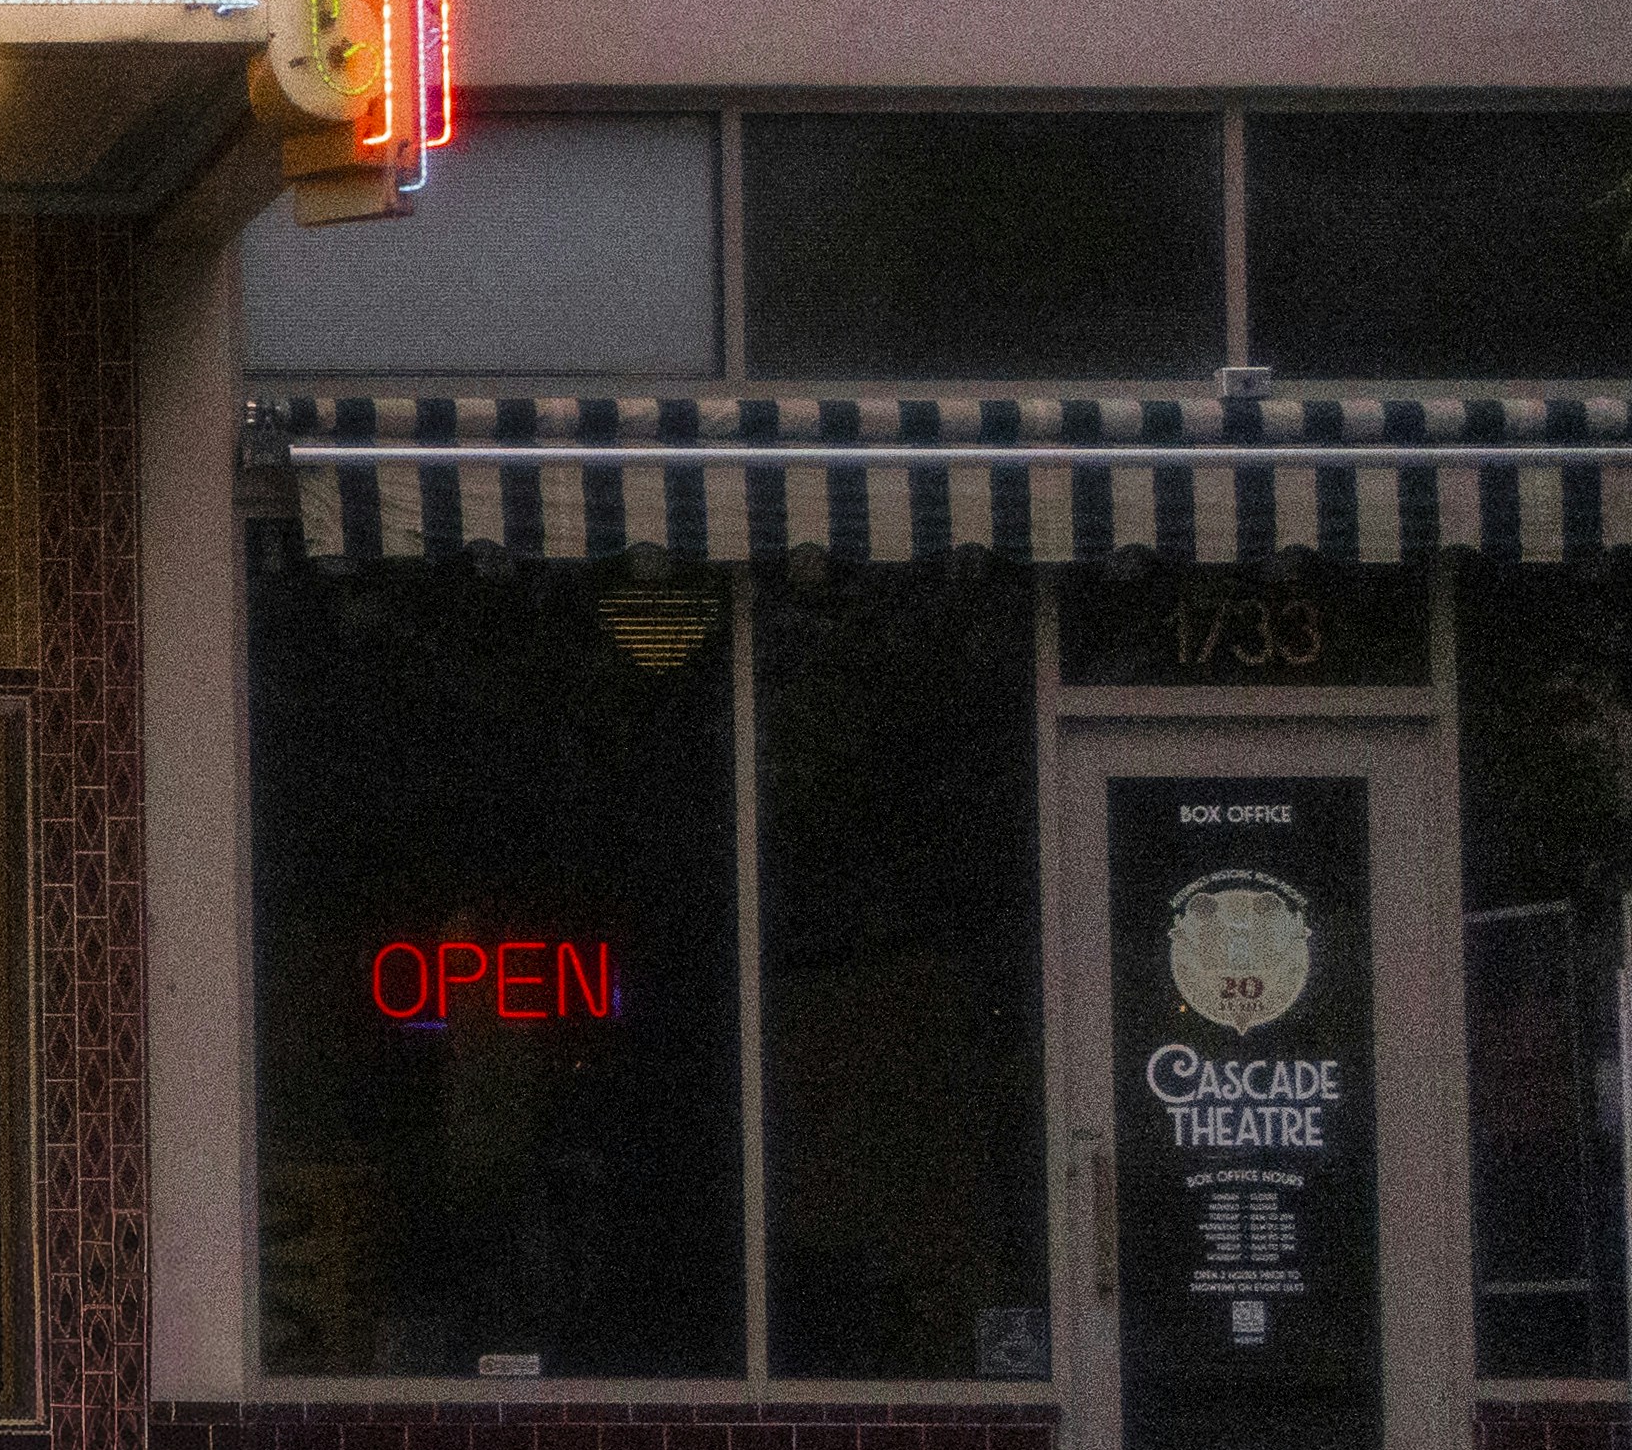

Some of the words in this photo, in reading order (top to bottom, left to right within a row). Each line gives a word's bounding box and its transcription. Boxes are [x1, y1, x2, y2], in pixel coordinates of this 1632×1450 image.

[1179, 805, 1221, 824] BOX
[1227, 805, 1292, 823] OFFICE
[372, 941, 609, 1018] OPEN
[1220, 976, 1264, 999] 20
[1146, 1043, 1340, 1103] CASCADE
[1166, 1106, 1323, 1146] THEATRE
[1186, 1173, 1213, 1188] BOX
[1217, 1170, 1258, 1183] OFFICE
[1262, 1171, 1304, 1187] HOURS
